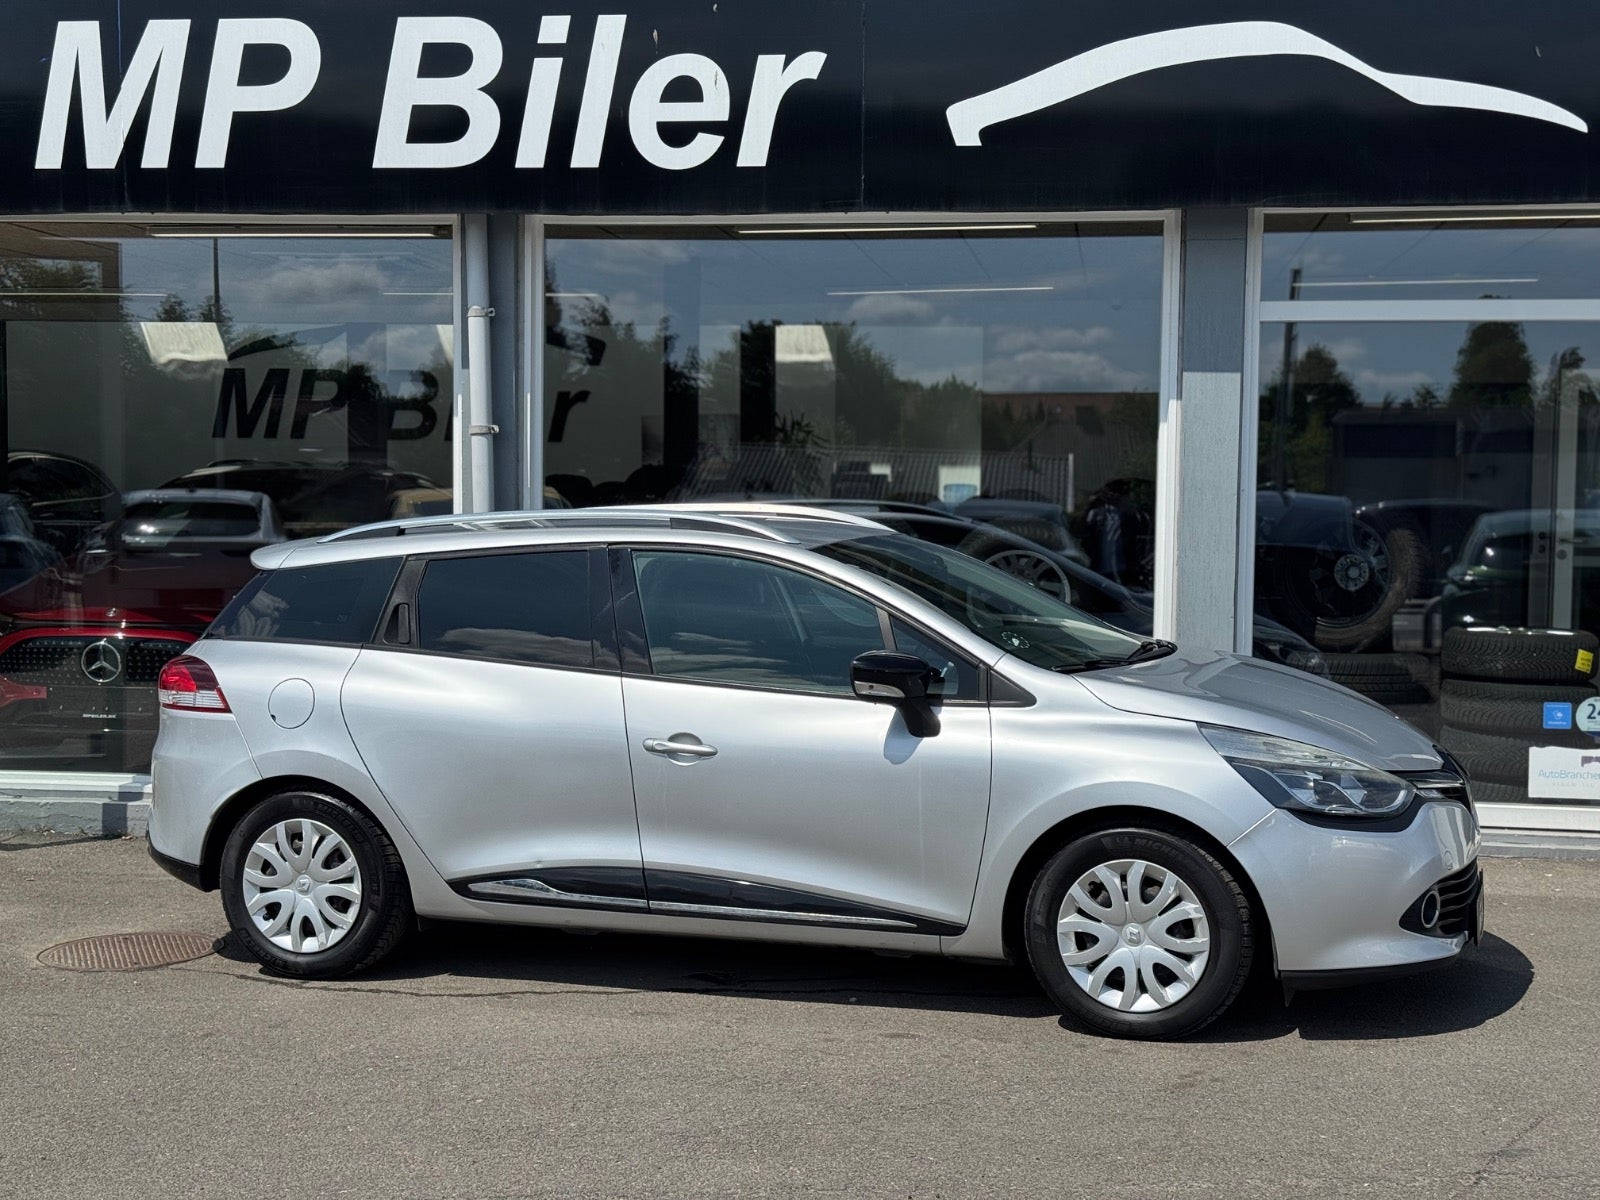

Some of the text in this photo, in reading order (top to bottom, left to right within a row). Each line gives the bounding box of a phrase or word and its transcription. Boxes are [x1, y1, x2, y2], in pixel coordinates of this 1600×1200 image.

[35, 14, 827, 170] MP Biler
[212, 368, 347, 440] MP
